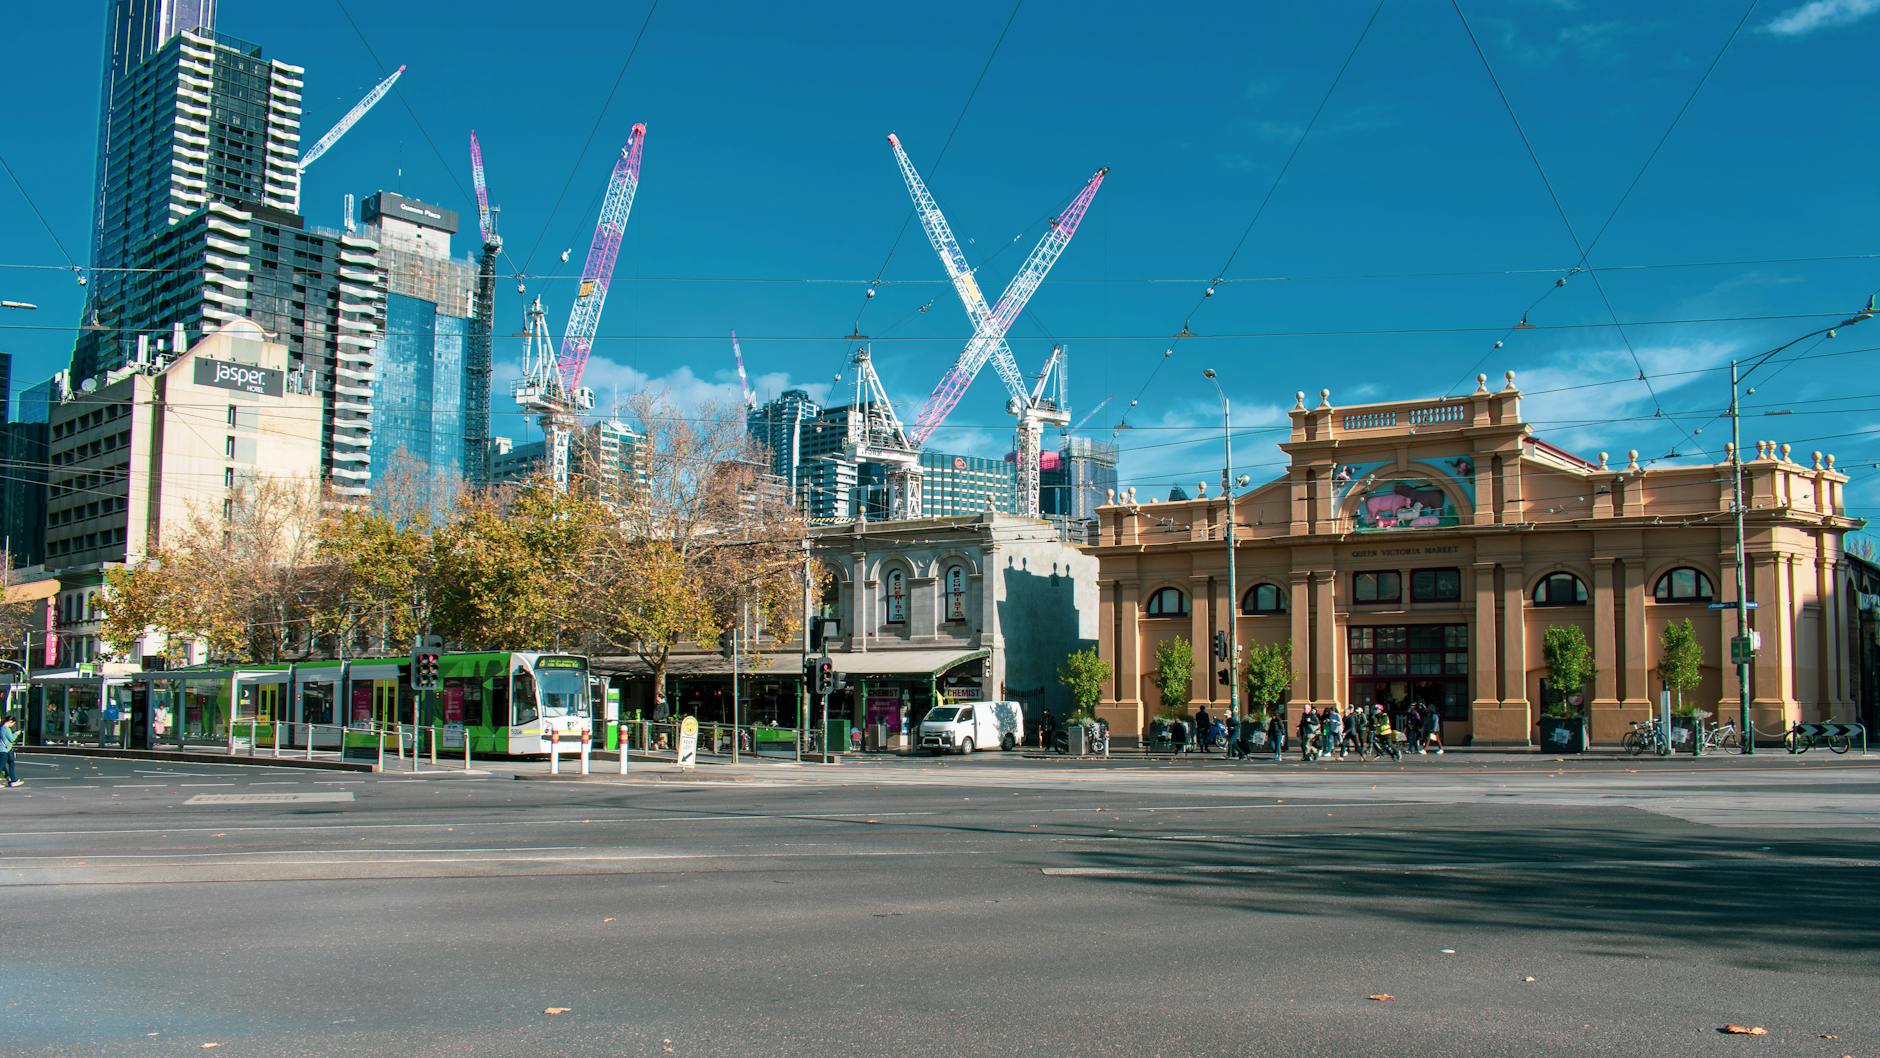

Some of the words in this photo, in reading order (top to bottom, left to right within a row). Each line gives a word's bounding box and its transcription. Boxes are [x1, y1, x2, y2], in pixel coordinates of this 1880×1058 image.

[400, 203, 424, 215] Queens
[424, 209, 441, 219] Place
[246, 385, 264, 394] HOTEL
[1352, 550, 1377, 558] QUEEN
[1382, 548, 1421, 557] VICTORIA
[1424, 545, 1458, 554] MARKET
[894, 581, 902, 613] CHEMIST
[953, 578, 961, 611] CHEMIST
[867, 688, 898, 697] CHEMIST
[947, 689, 980, 697] CHEMIST
